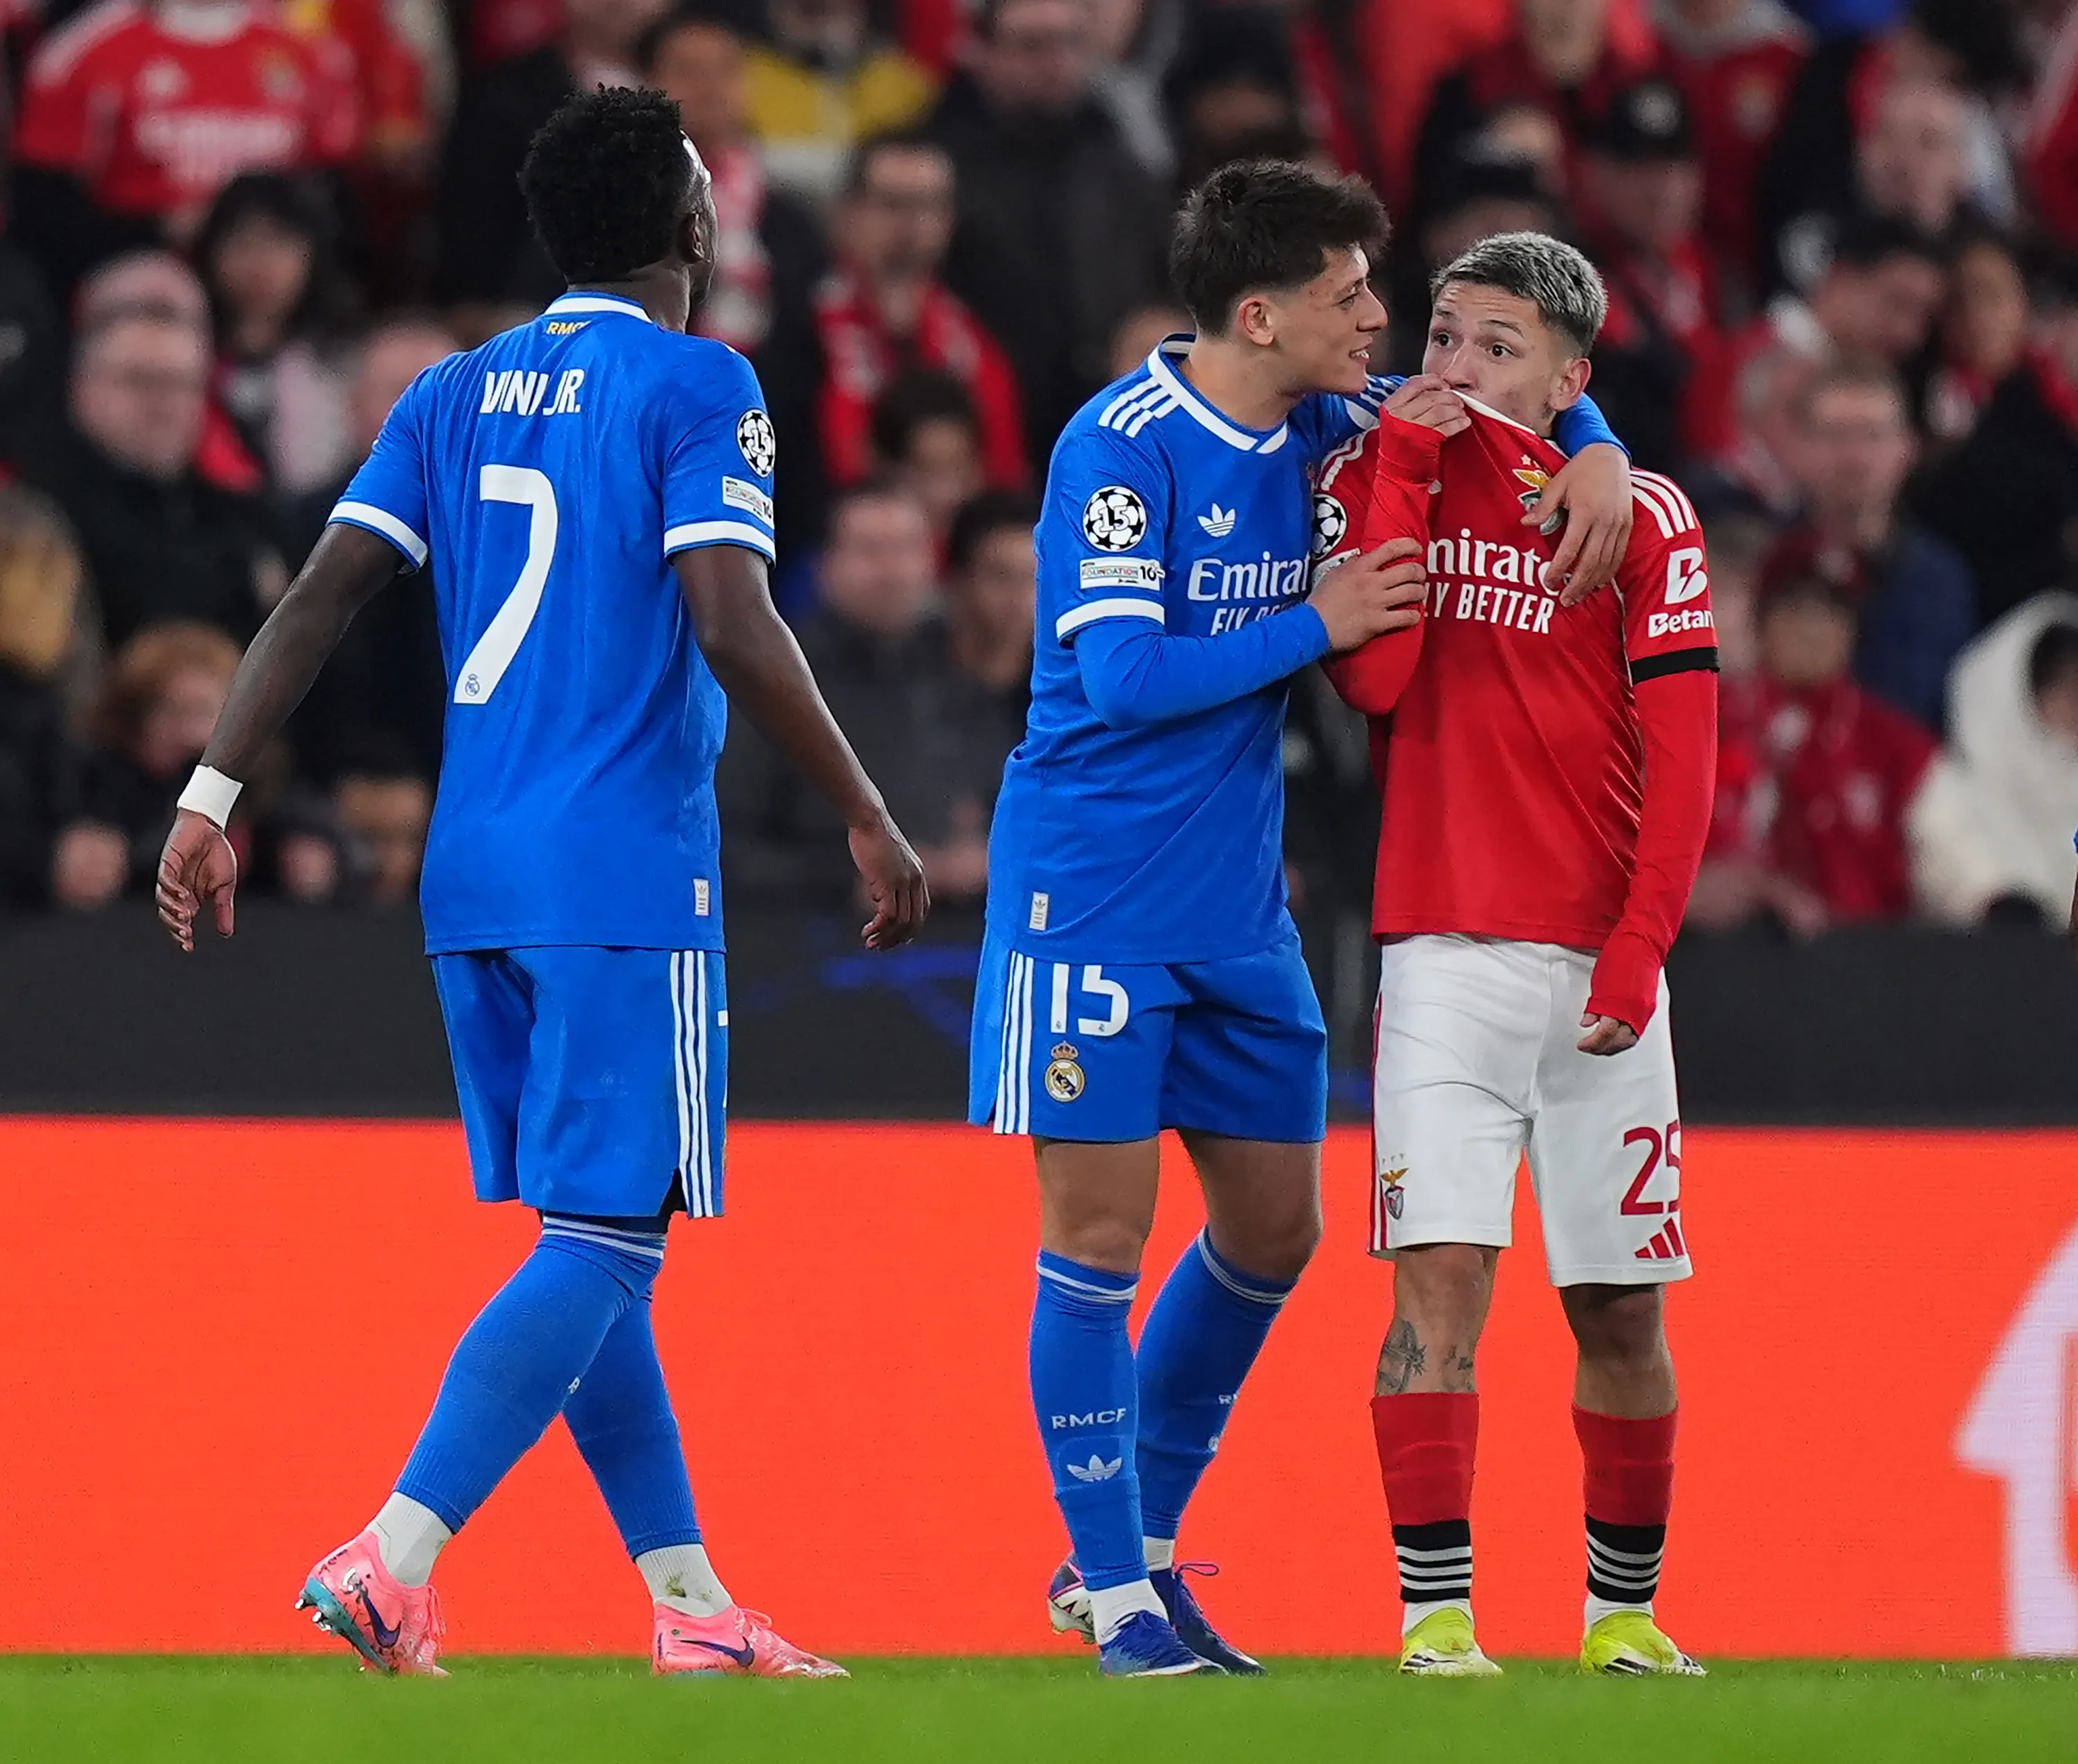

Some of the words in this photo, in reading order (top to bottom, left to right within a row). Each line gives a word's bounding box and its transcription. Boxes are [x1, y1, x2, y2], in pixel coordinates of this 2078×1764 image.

[546, 321, 592, 336] RMC
[479, 369, 549, 416] VINI
[542, 368, 585, 416] JR.
[1098, 505, 1131, 533] 15
[454, 463, 558, 704] 7
[1455, 583, 1556, 634] BETTER
[1050, 962, 1130, 1037] 15
[1049, 1407, 1127, 1429] RMCF
